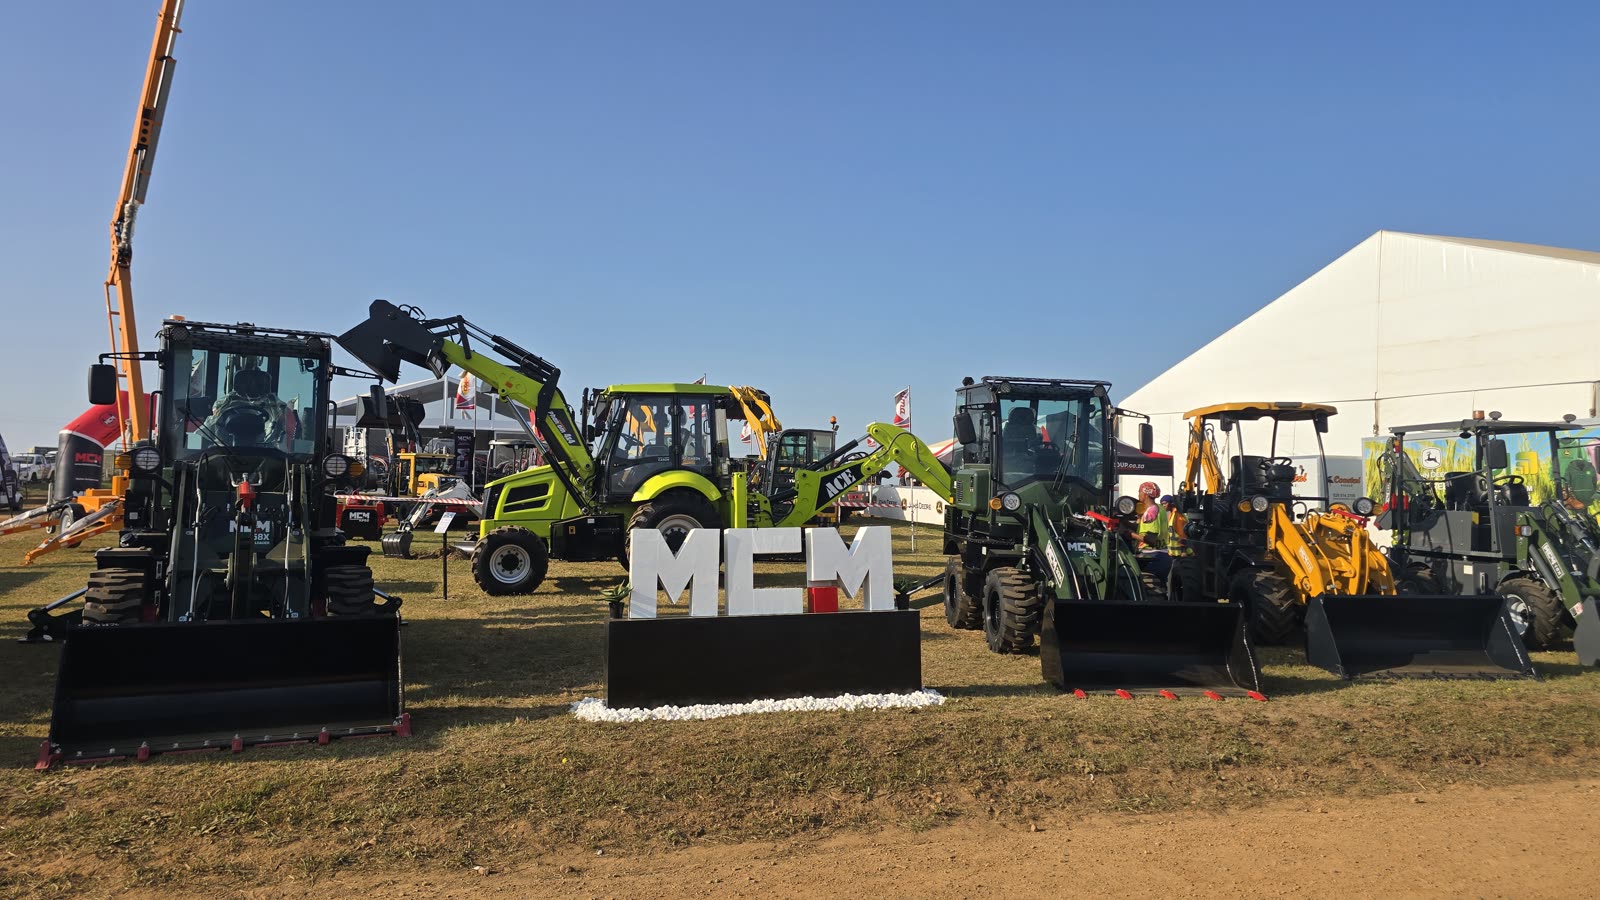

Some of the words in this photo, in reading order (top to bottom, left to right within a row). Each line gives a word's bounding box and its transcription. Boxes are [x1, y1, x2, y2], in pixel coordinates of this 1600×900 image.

[826, 468, 857, 499] ACE
[349, 511, 370, 519] MCM
[1067, 542, 1097, 553] MCM
[629, 525, 896, 620] MCM
